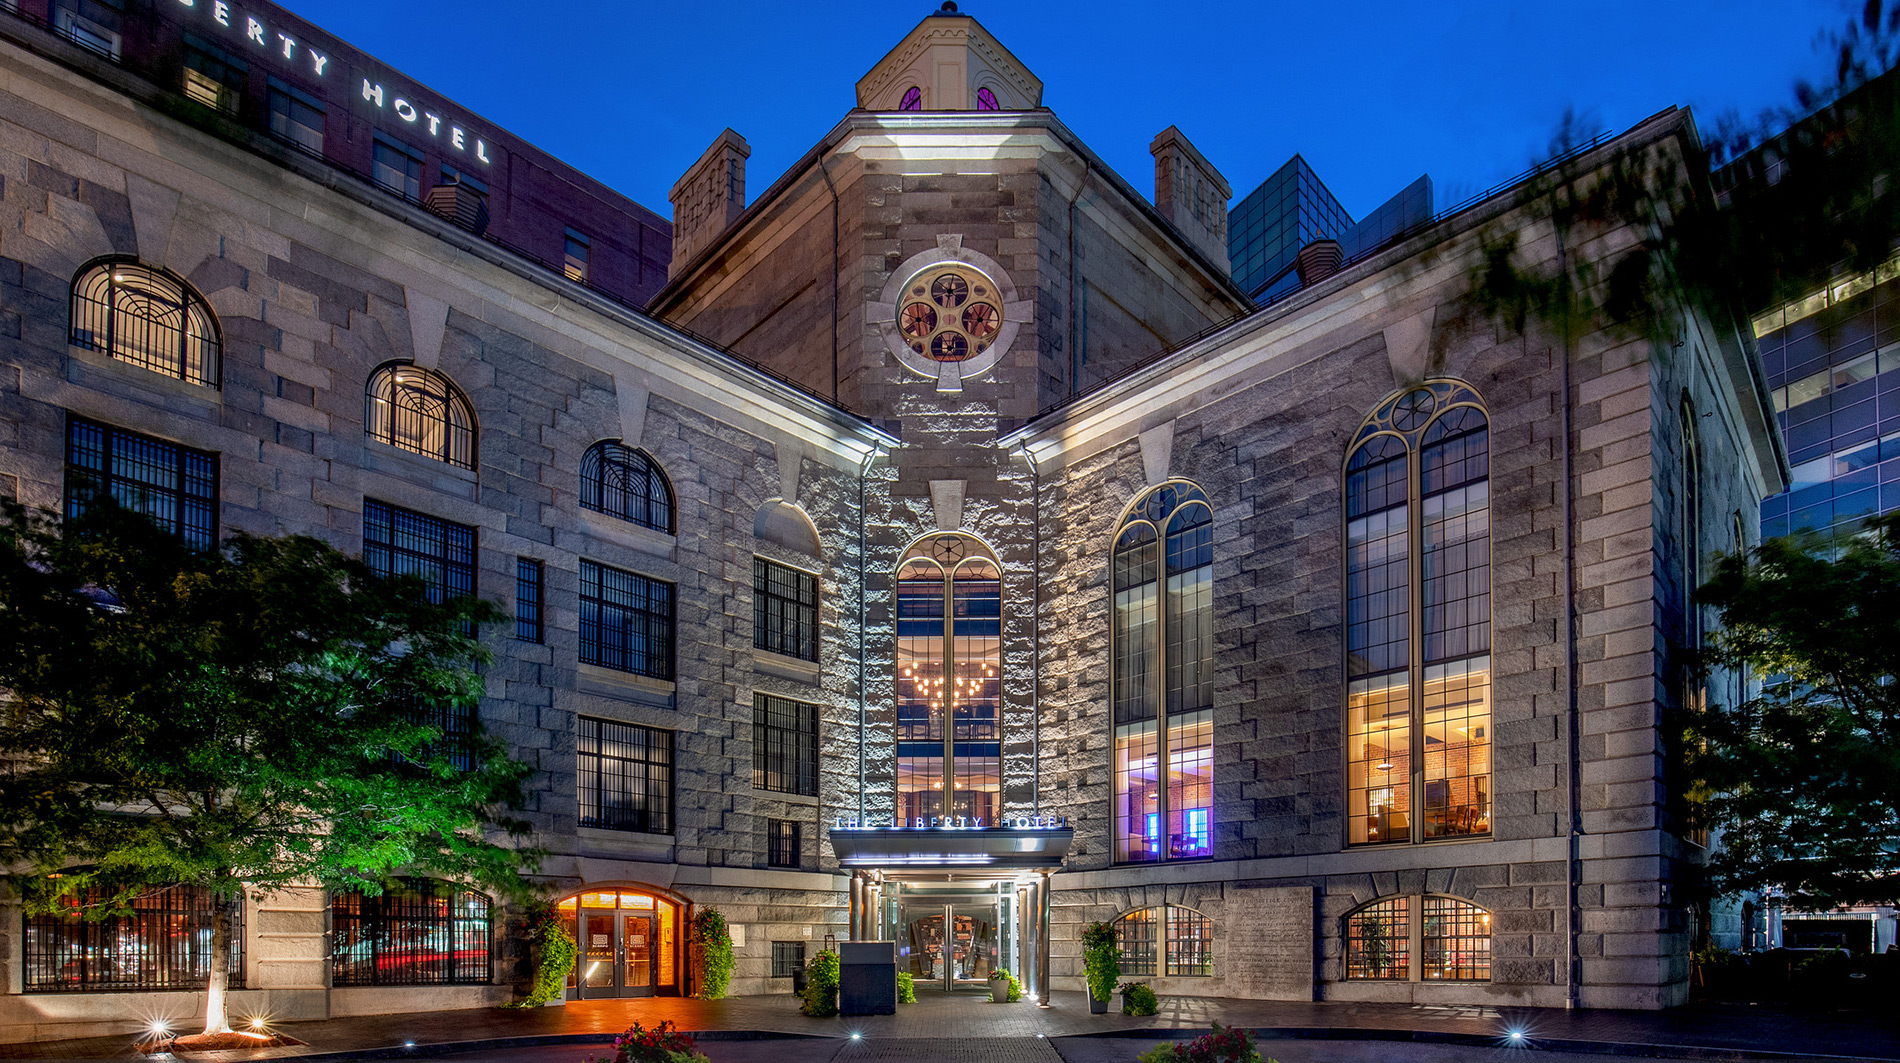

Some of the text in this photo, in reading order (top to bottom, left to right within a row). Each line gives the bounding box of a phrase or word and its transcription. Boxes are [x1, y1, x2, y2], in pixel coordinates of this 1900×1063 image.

[179, 0, 490, 164] ERTY HOTEL
[834, 817, 873, 829] THE
